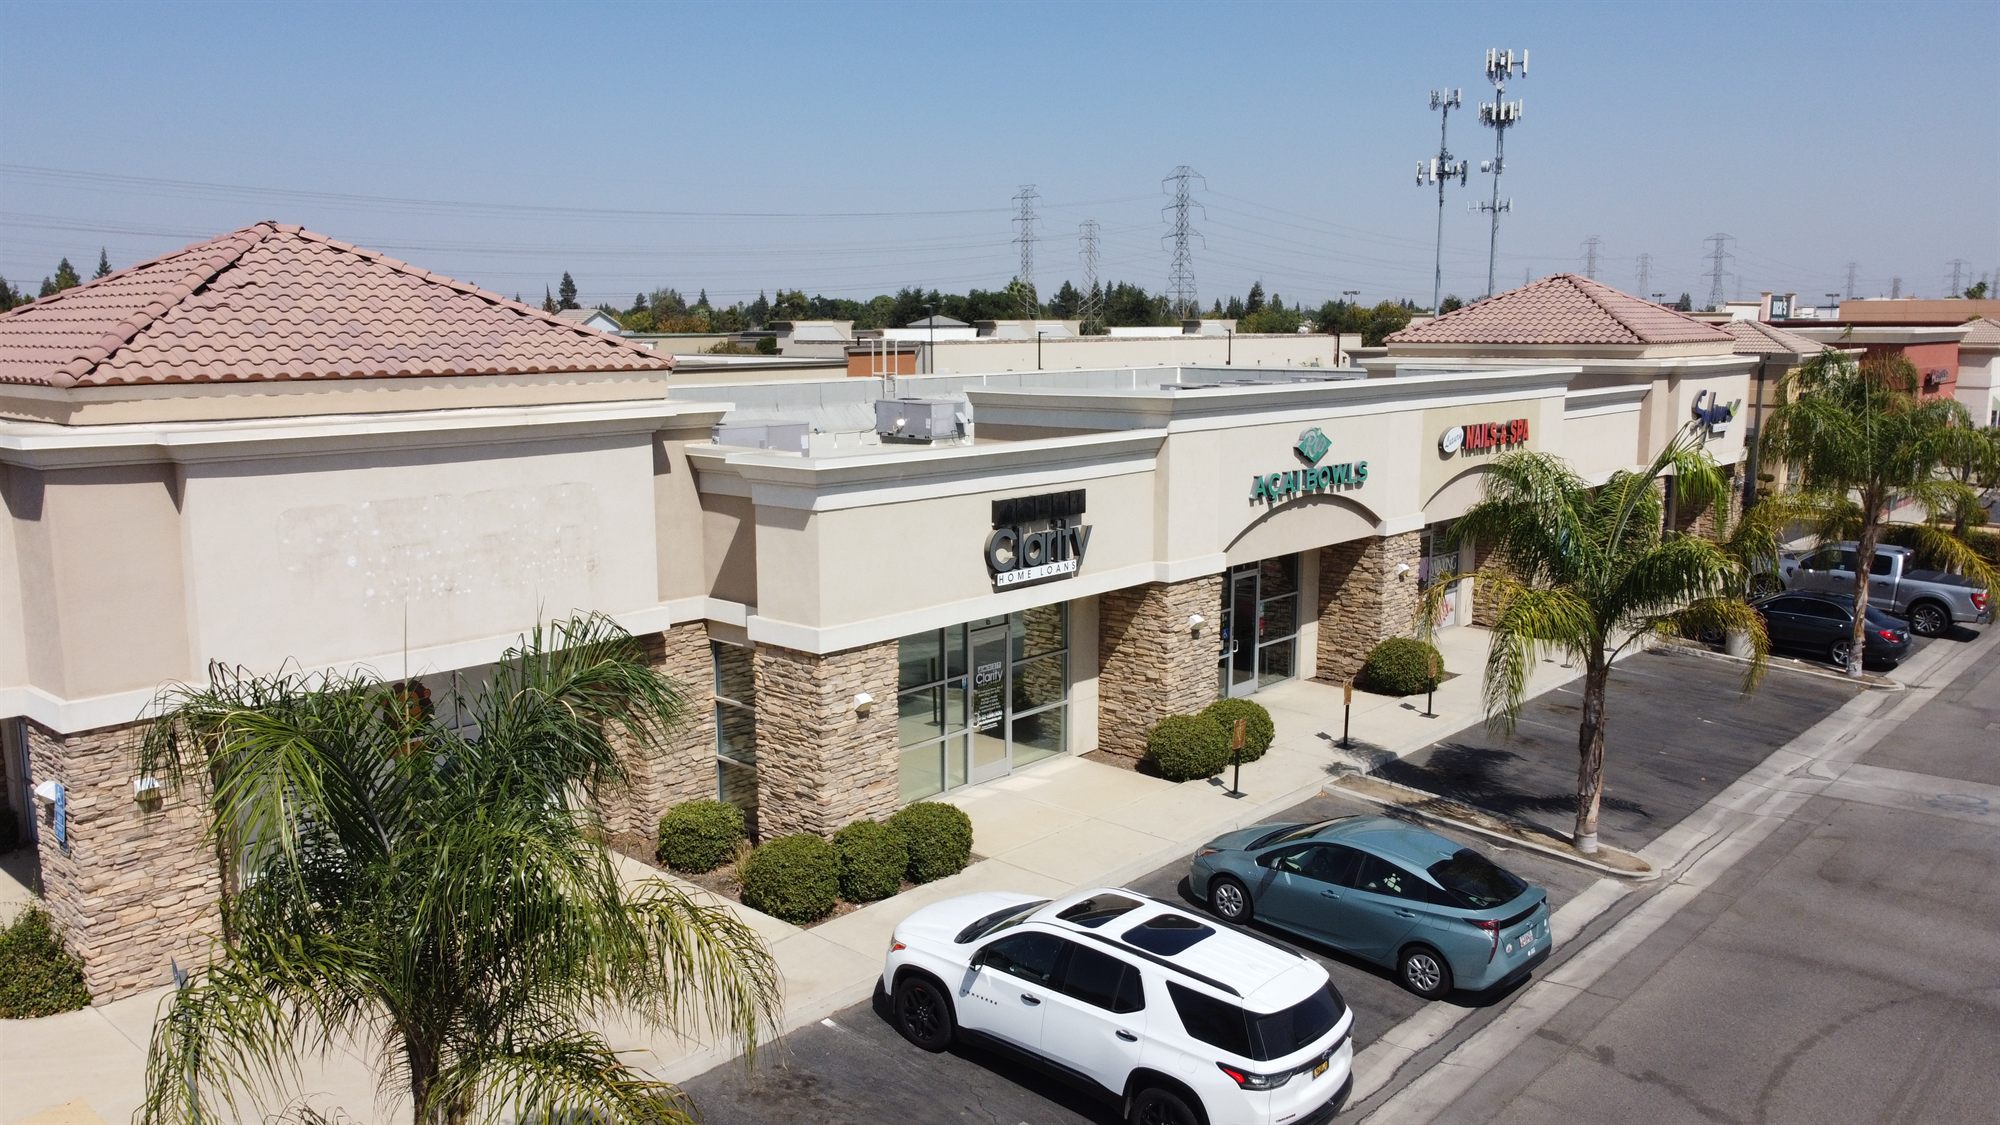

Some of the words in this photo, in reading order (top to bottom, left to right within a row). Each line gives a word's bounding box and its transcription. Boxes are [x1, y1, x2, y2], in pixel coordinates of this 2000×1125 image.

[1464, 422, 1497, 449] NAILS
[1499, 424, 1507, 445] &
[1509, 419, 1529, 444] SPA
[1252, 471, 1301, 503] AÇAI
[1303, 461, 1369, 491] BOWLS
[984, 520, 1092, 578] Clarity
[998, 569, 1032, 584] HOME
[1040, 560, 1076, 576] LOANS
[976, 670, 1003, 684] Clarity
